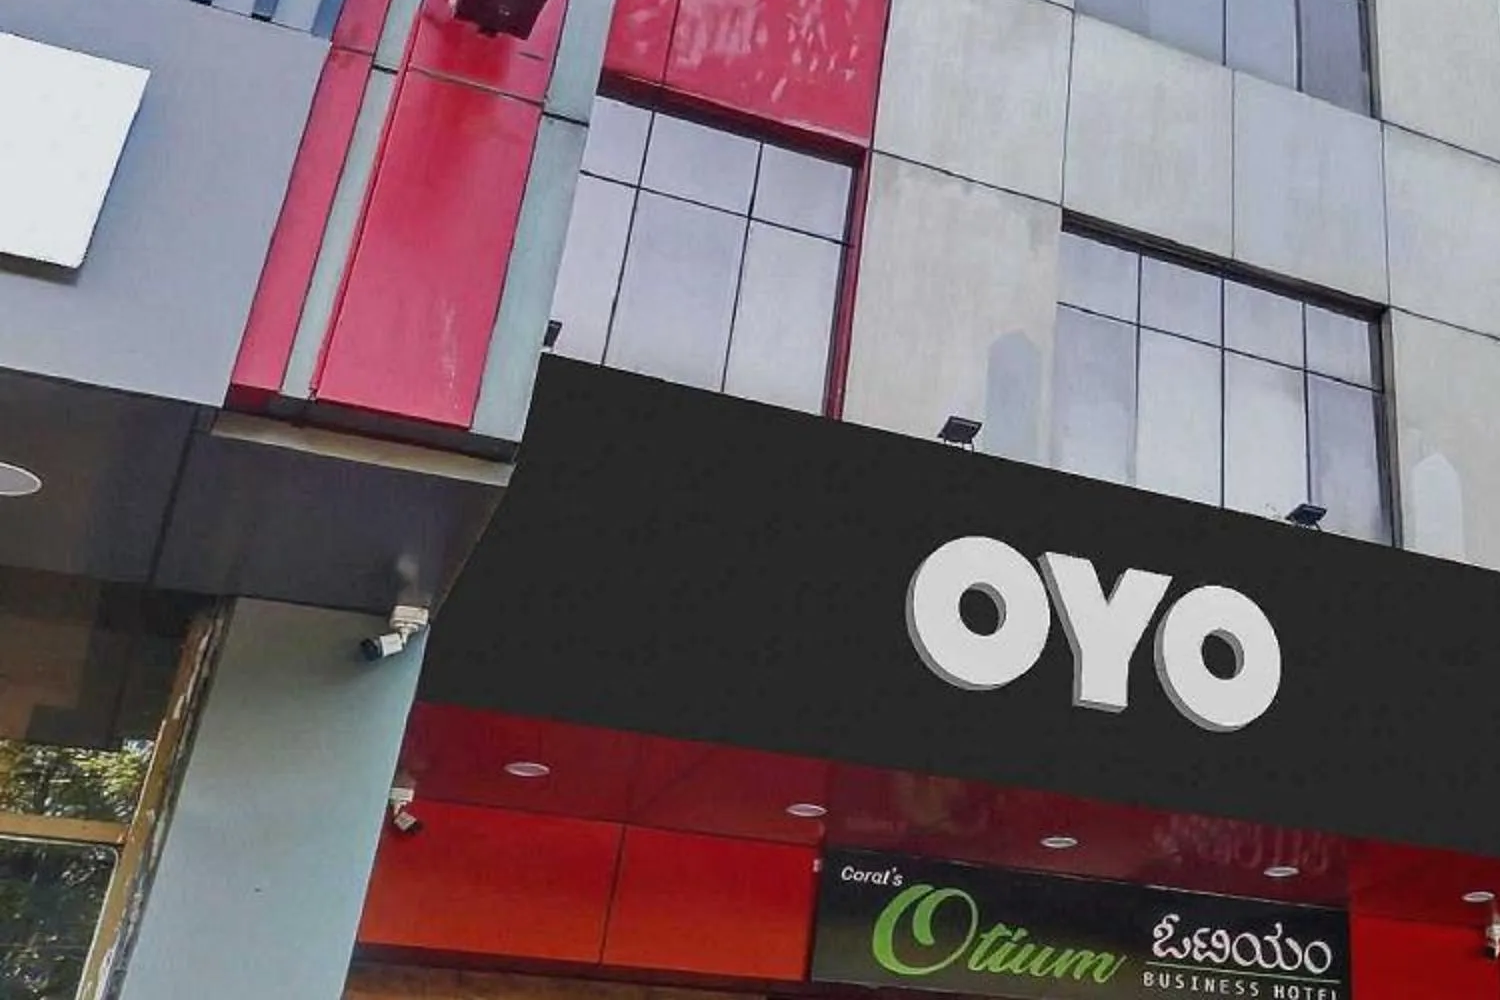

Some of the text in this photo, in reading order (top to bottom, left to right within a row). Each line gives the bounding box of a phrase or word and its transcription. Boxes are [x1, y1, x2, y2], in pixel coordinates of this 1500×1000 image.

[906, 535, 1282, 733] OYO
[841, 865, 903, 887] Coral's
[871, 884, 1129, 984] Otium
[1143, 973, 1260, 998] BUSINESS
